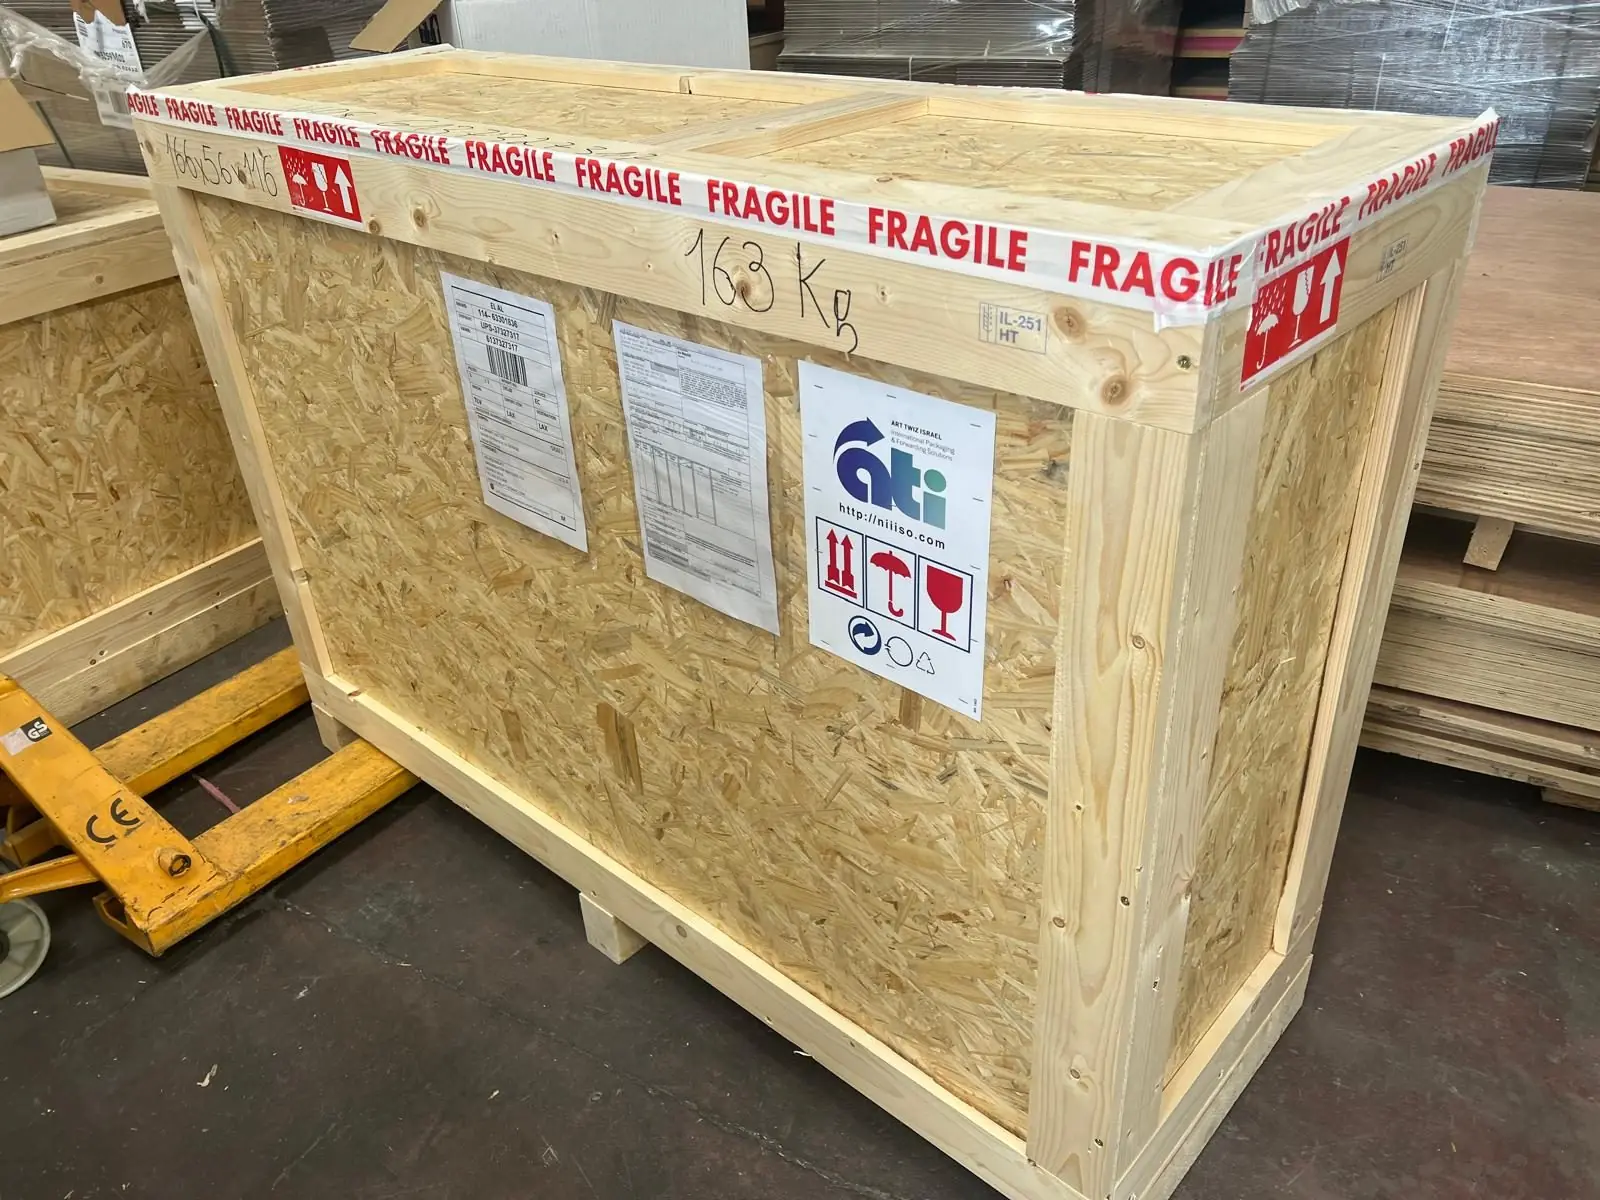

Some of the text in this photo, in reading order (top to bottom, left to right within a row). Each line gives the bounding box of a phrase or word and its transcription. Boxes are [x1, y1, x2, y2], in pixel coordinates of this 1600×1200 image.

[165, 97, 218, 126] FRAGILE
[224, 106, 284, 136] FRAGILE
[293, 117, 360, 148] FRAGILE
[370, 130, 450, 165] FRAGILE
[465, 139, 556, 183] FRAGILE
[575, 157, 682, 206] FRAGILE
[707, 178, 836, 236] FRAGILE
[868, 206, 1028, 272] FRAGILE
[1067, 240, 1243, 307] FRAGILE
[1358, 153, 1438, 221] FRAGILE
[684, 228, 775, 312] 163
[999, 311, 1042, 332] IL-251
[999, 328, 1020, 344] HT
[890, 420, 942, 441] ART TWIZ ISRAEL
[839, 502, 946, 550] http://niiiso.com
[86, 797, 141, 844] CE
